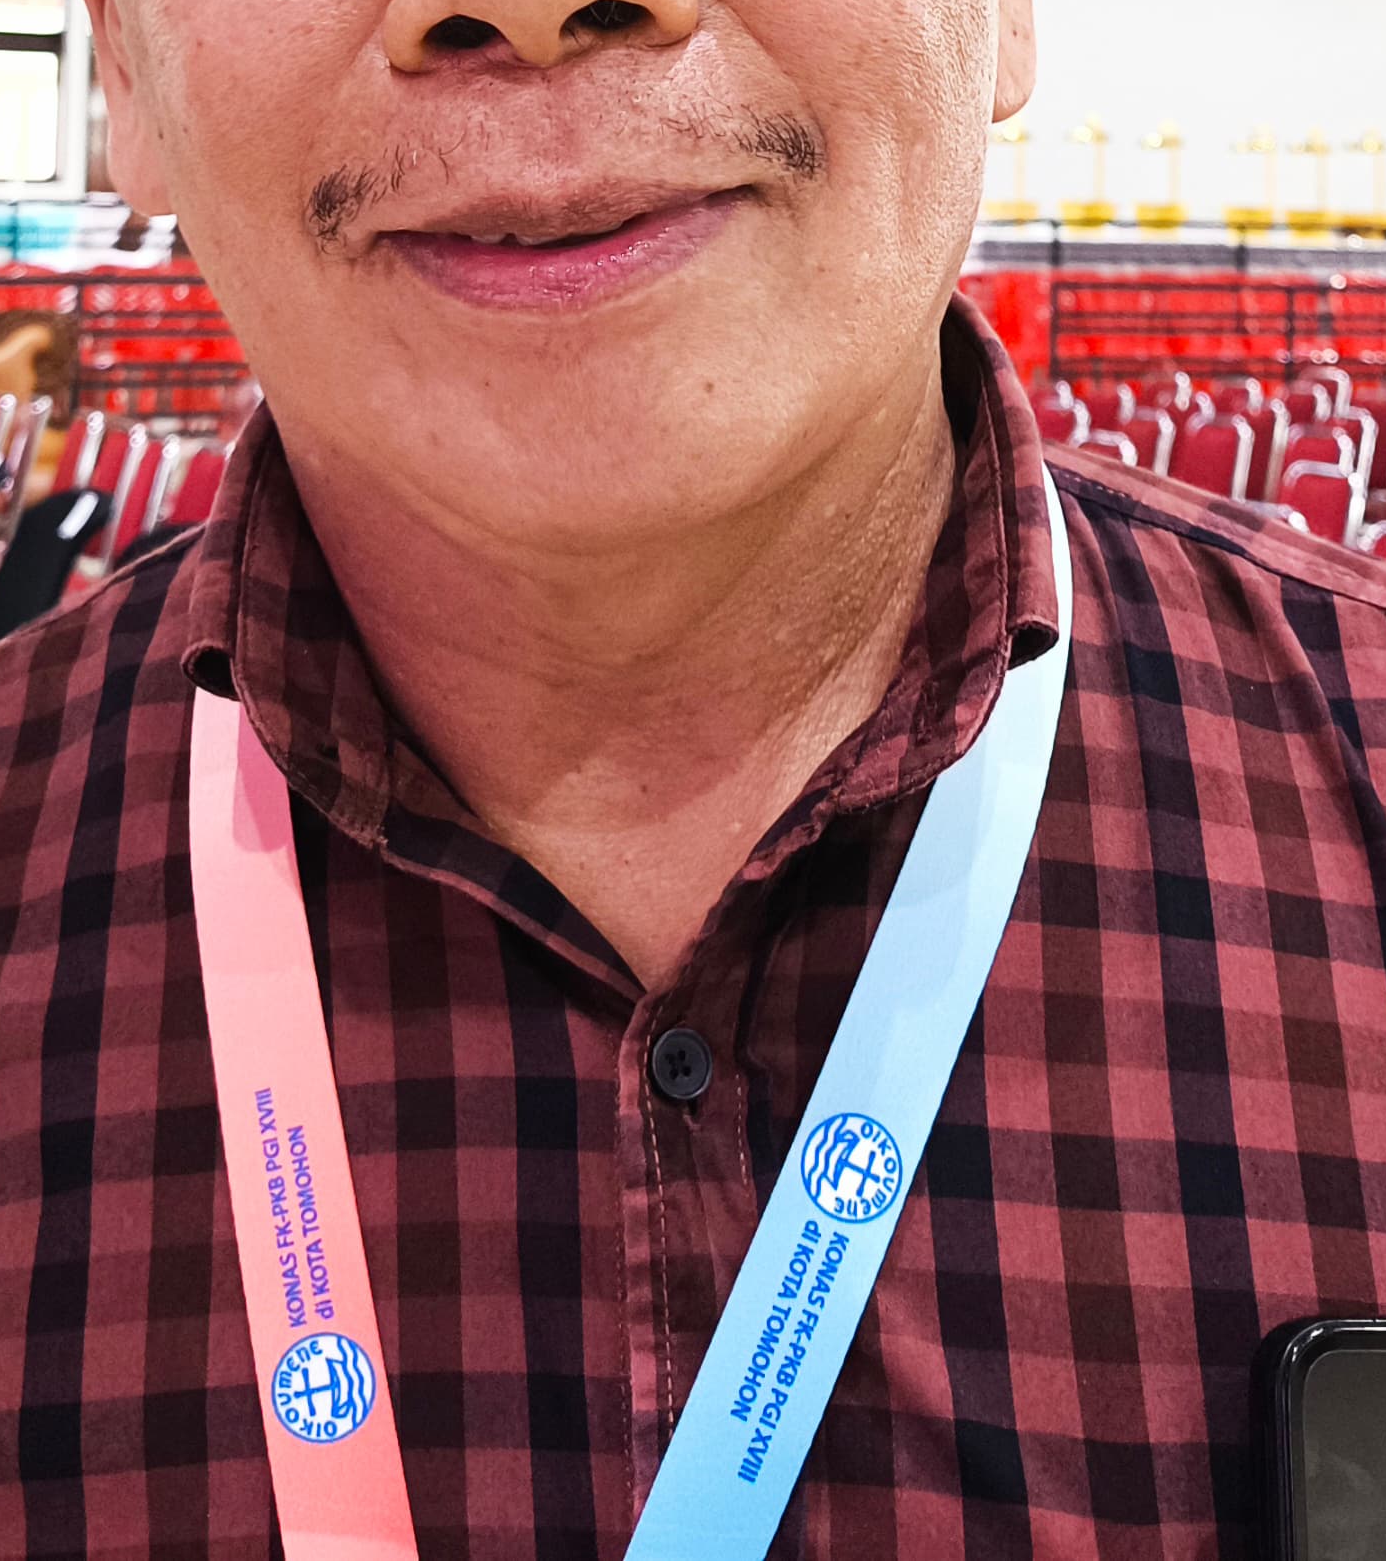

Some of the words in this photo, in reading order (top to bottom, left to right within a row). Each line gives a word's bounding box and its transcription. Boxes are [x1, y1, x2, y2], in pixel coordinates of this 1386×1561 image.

[255, 1088, 276, 1134] XVIII
[263, 1137, 282, 1173] PGI
[288, 1125, 320, 1237] TOMOHON
[268, 1176, 295, 1249] FK-PKB
[280, 1253, 306, 1329] KONAS
[307, 1239, 330, 1297] KOTA
[777, 1242, 815, 1299] KOTA
[808, 1232, 850, 1310] KONAS
[315, 1299, 334, 1320] di
[730, 1305, 791, 1422] TOMOHON
[775, 1309, 820, 1389] FK-PKB
[759, 1388, 789, 1429] PGI
[737, 1427, 773, 1484] XVIII
